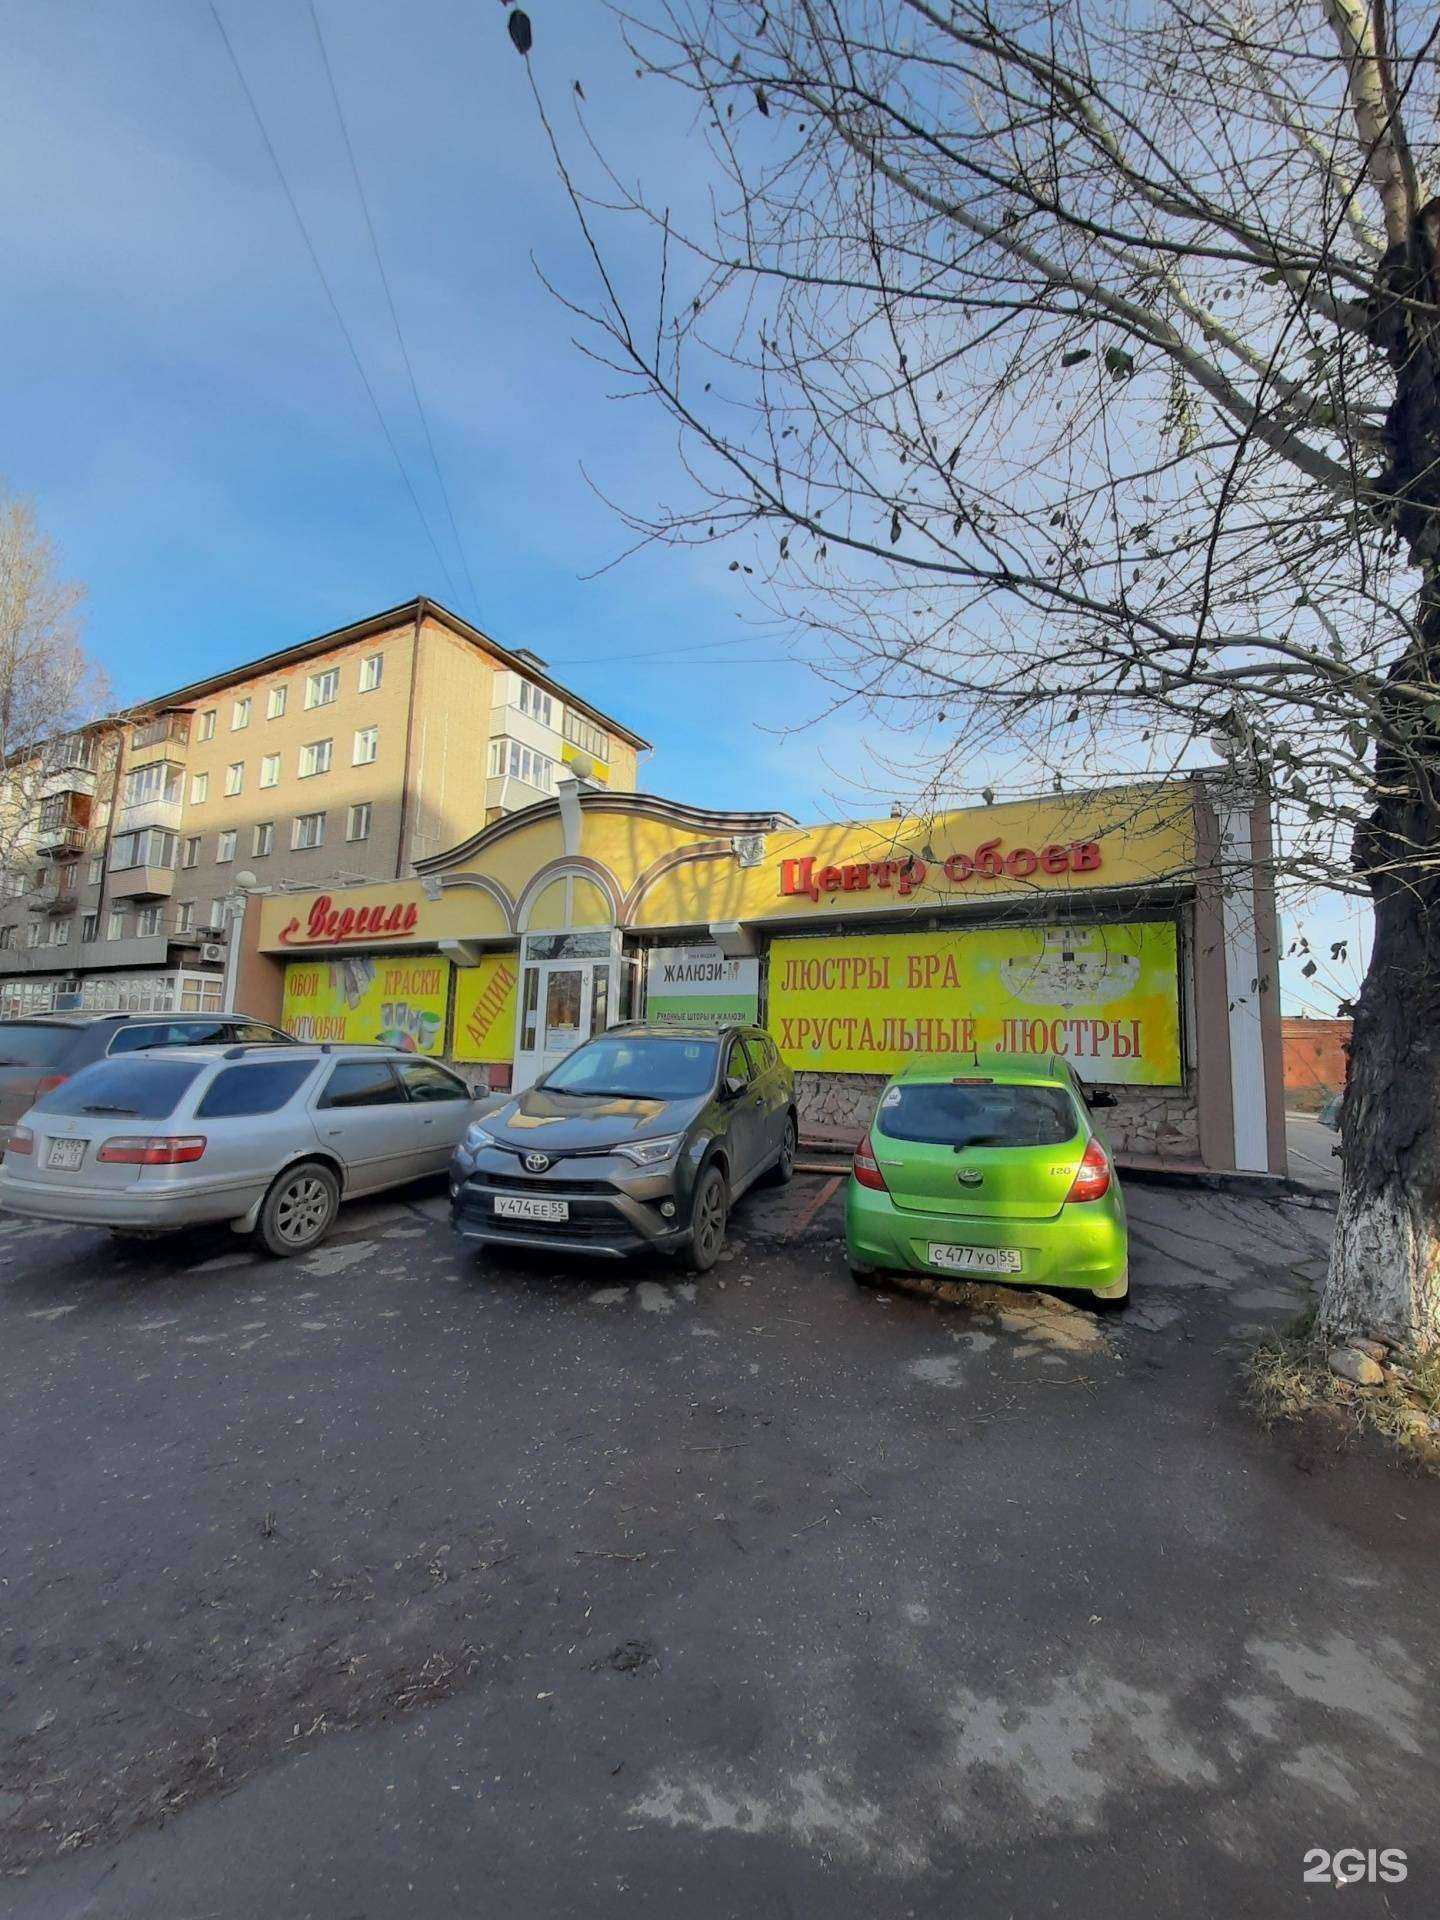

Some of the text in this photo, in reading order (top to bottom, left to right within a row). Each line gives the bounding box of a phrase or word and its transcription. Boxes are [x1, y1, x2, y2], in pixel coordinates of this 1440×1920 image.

[777, 836, 1102, 902] Центр обоев
[290, 972, 318, 997] ОБОИ
[384, 969, 441, 996] КРАСКИ
[781, 953, 962, 991] ЛЮСТРЫ БРА
[466, 963, 517, 1047] АКЦИИ
[285, 1015, 347, 1040] ФОТООБОИ
[779, 1016, 1143, 1059] ХРУСТАЛЬНЫЕ ЛЮСТРЫ
